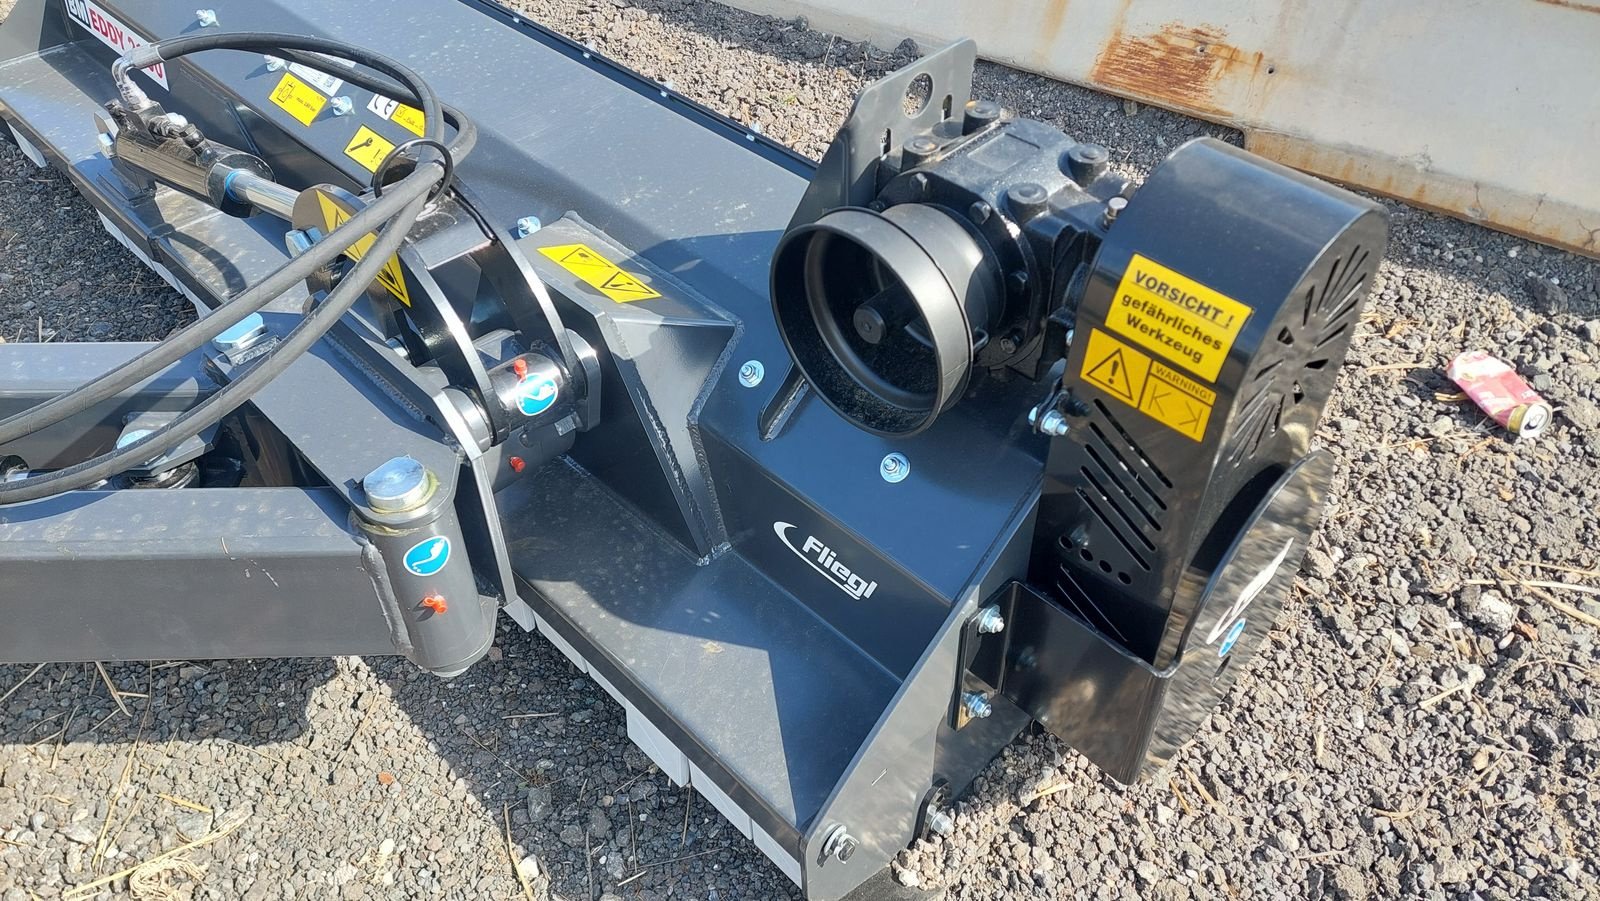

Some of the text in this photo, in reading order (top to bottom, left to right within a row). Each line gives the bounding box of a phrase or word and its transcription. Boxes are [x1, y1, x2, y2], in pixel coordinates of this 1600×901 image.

[89, 8, 124, 50] EDDY
[1135, 269, 1224, 322] VORSICHT
[1121, 294, 1223, 351] gefährliches
[1126, 313, 1204, 364] Werkzeug
[1155, 365, 1212, 400] WARNING!
[802, 535, 878, 599] Fliegl
